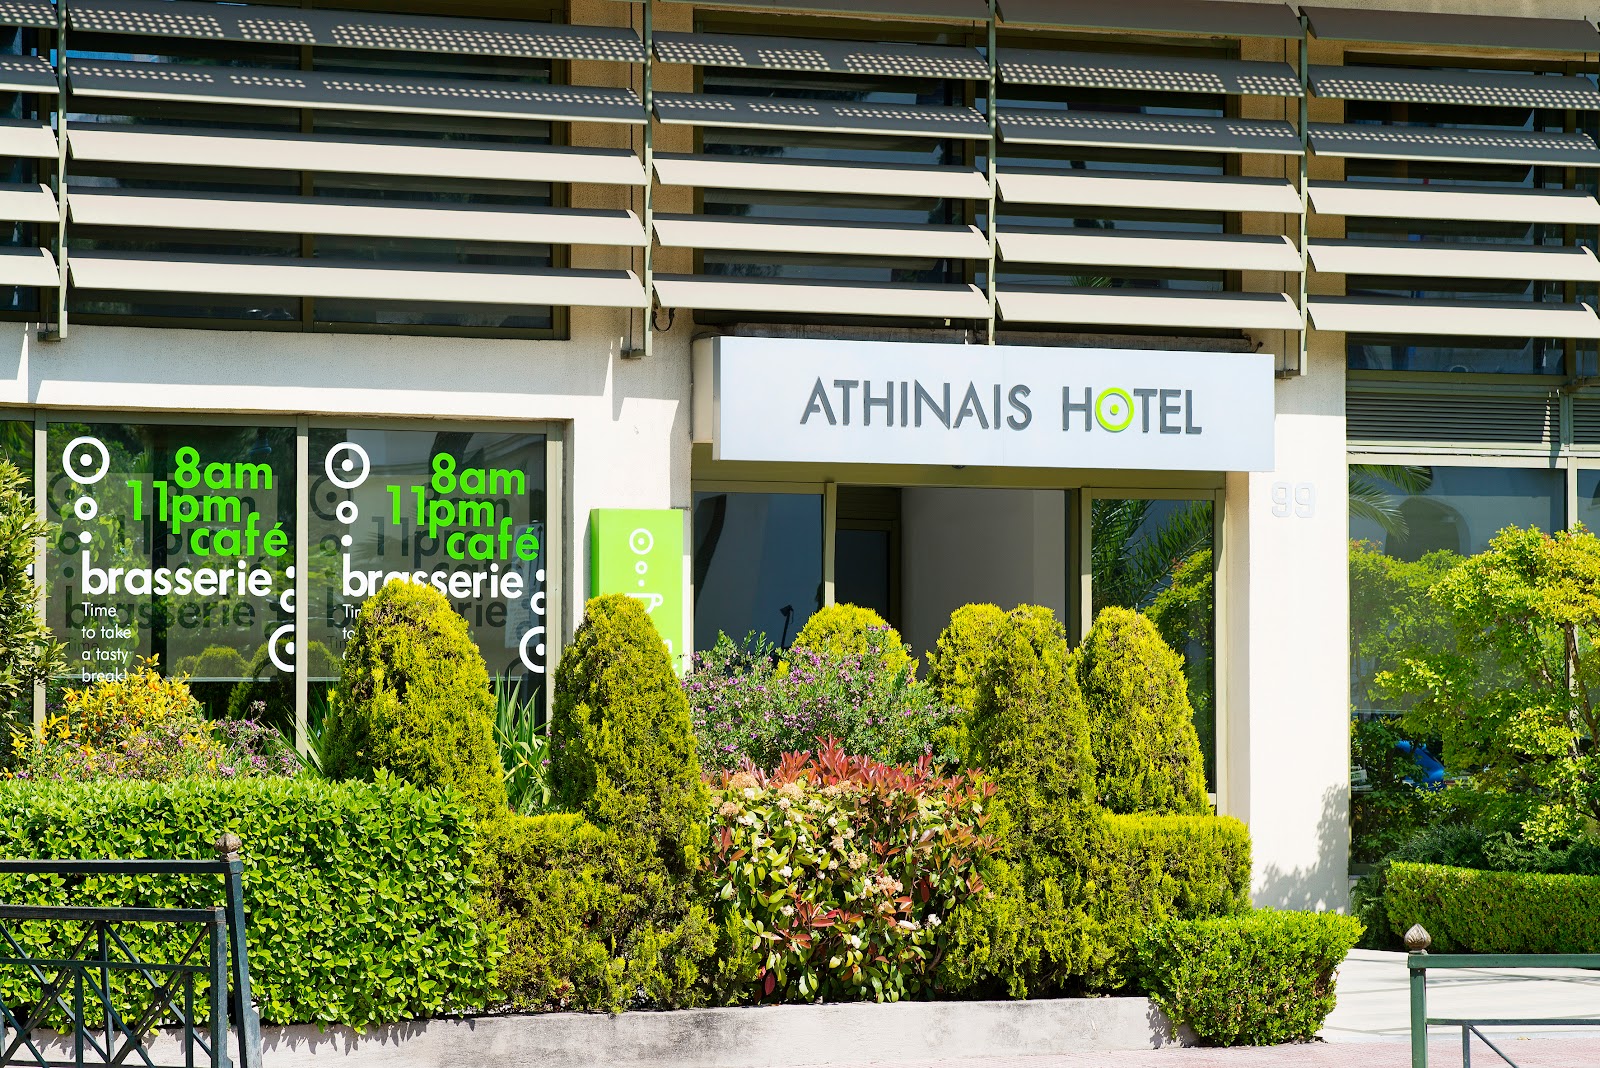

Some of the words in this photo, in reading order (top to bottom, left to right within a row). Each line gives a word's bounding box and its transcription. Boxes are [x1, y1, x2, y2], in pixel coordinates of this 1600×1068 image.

[800, 375, 1032, 431] ATHINAIS
[1062, 385, 1203, 434] HOTEL
[174, 446, 273, 490] 8am
[431, 452, 525, 496] 8am
[127, 480, 241, 535] 11pm
[386, 485, 495, 539] 11pm
[1272, 481, 1316, 518] 99
[190, 511, 289, 557] café
[446, 517, 540, 561] café
[81, 550, 273, 596] brasserie
[81, 601, 117, 617] Time
[81, 625, 96, 639] to
[100, 623, 132, 639] take
[81, 650, 91, 661] a
[96, 647, 129, 665] tasty
